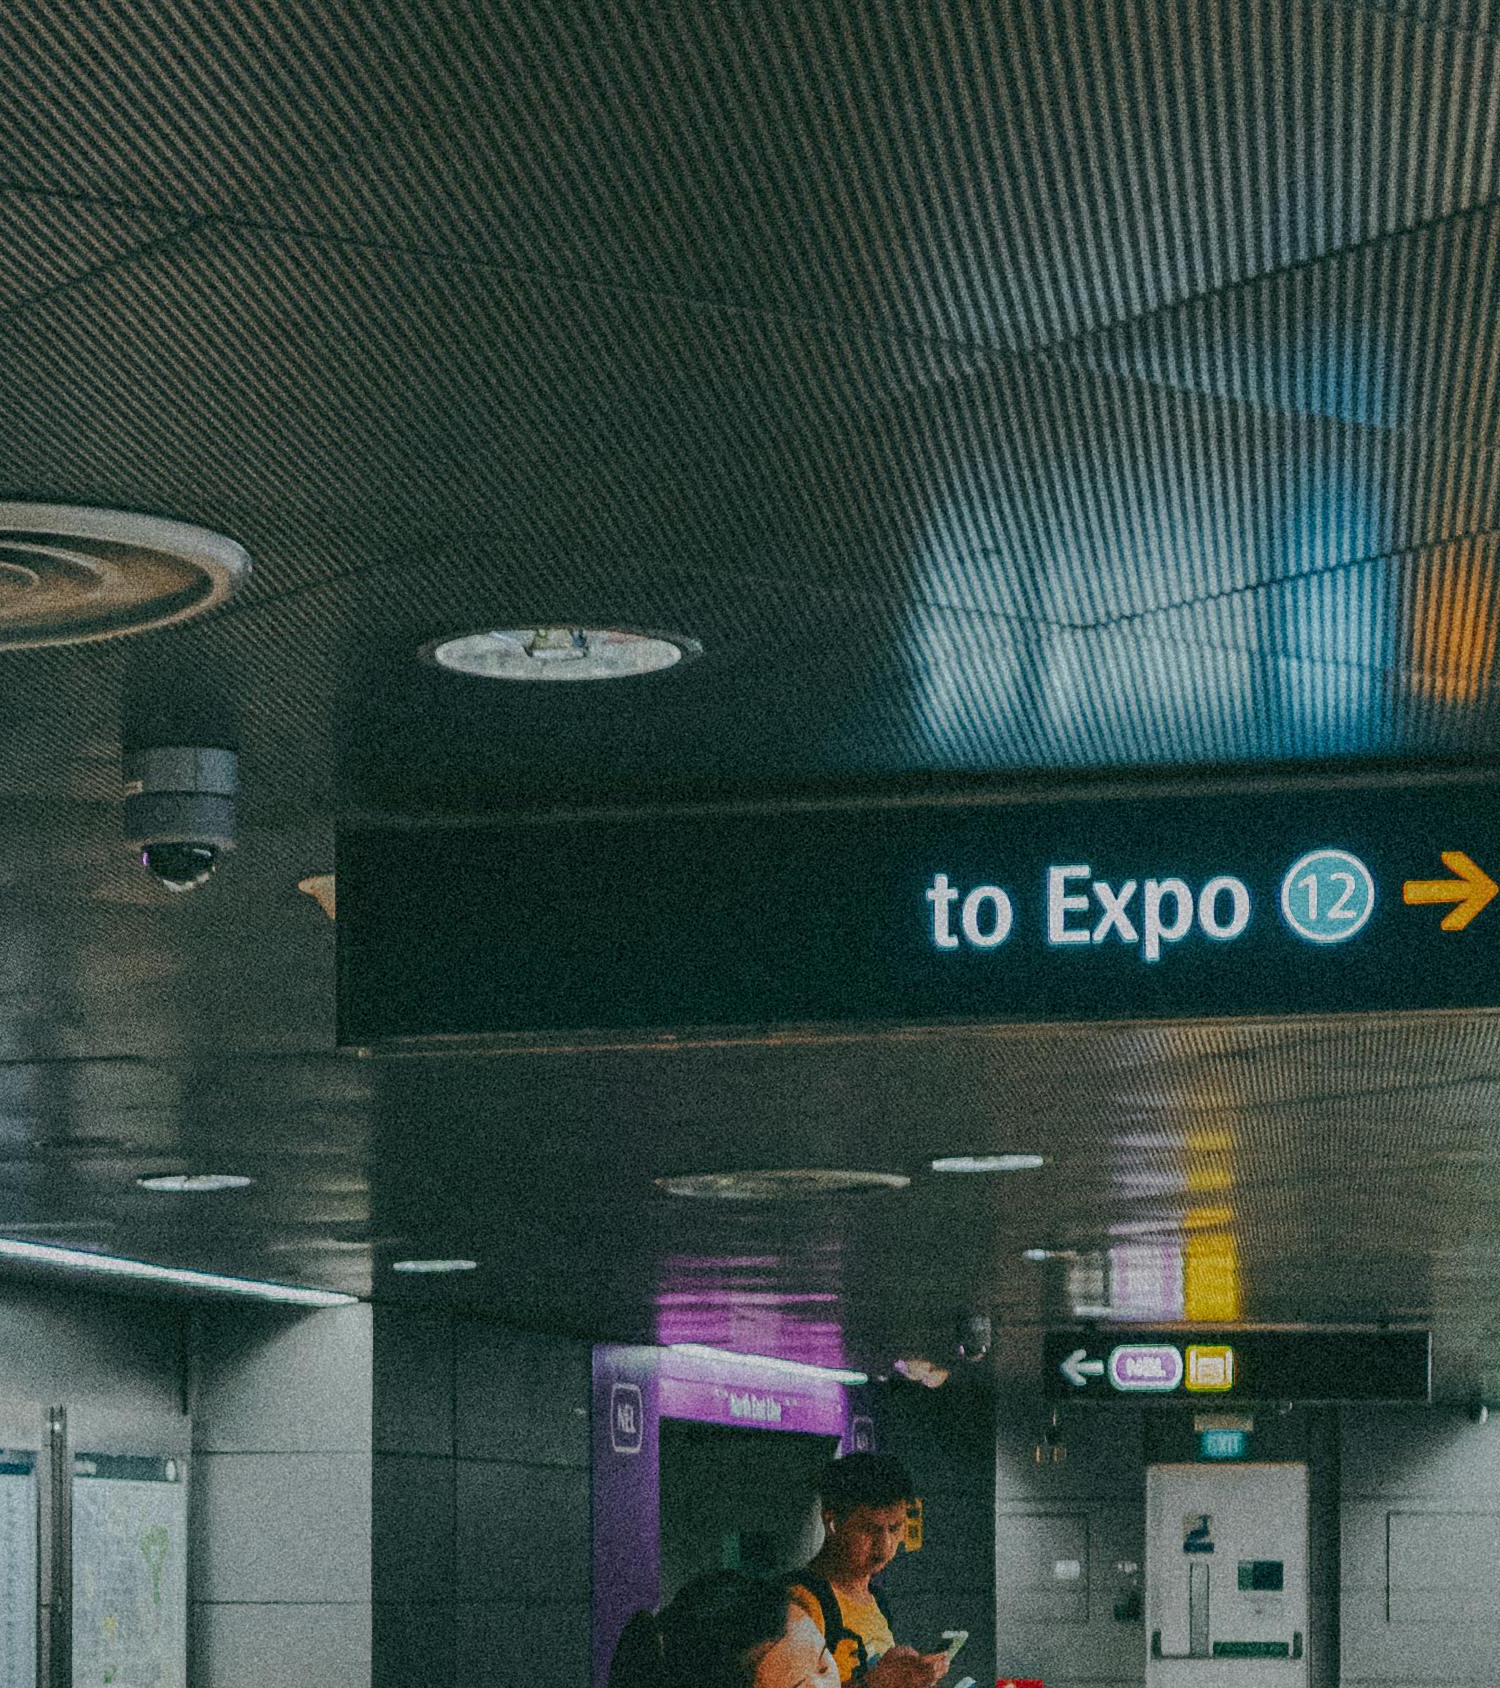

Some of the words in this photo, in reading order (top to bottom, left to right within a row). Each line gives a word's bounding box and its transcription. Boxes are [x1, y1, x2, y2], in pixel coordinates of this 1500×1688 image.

[925, 872, 1014, 947] to
[1046, 863, 1251, 962] Expo
[1297, 871, 1358, 922] 12
[1126, 1356, 1166, 1378] NEL
[617, 1402, 637, 1434] NEL
